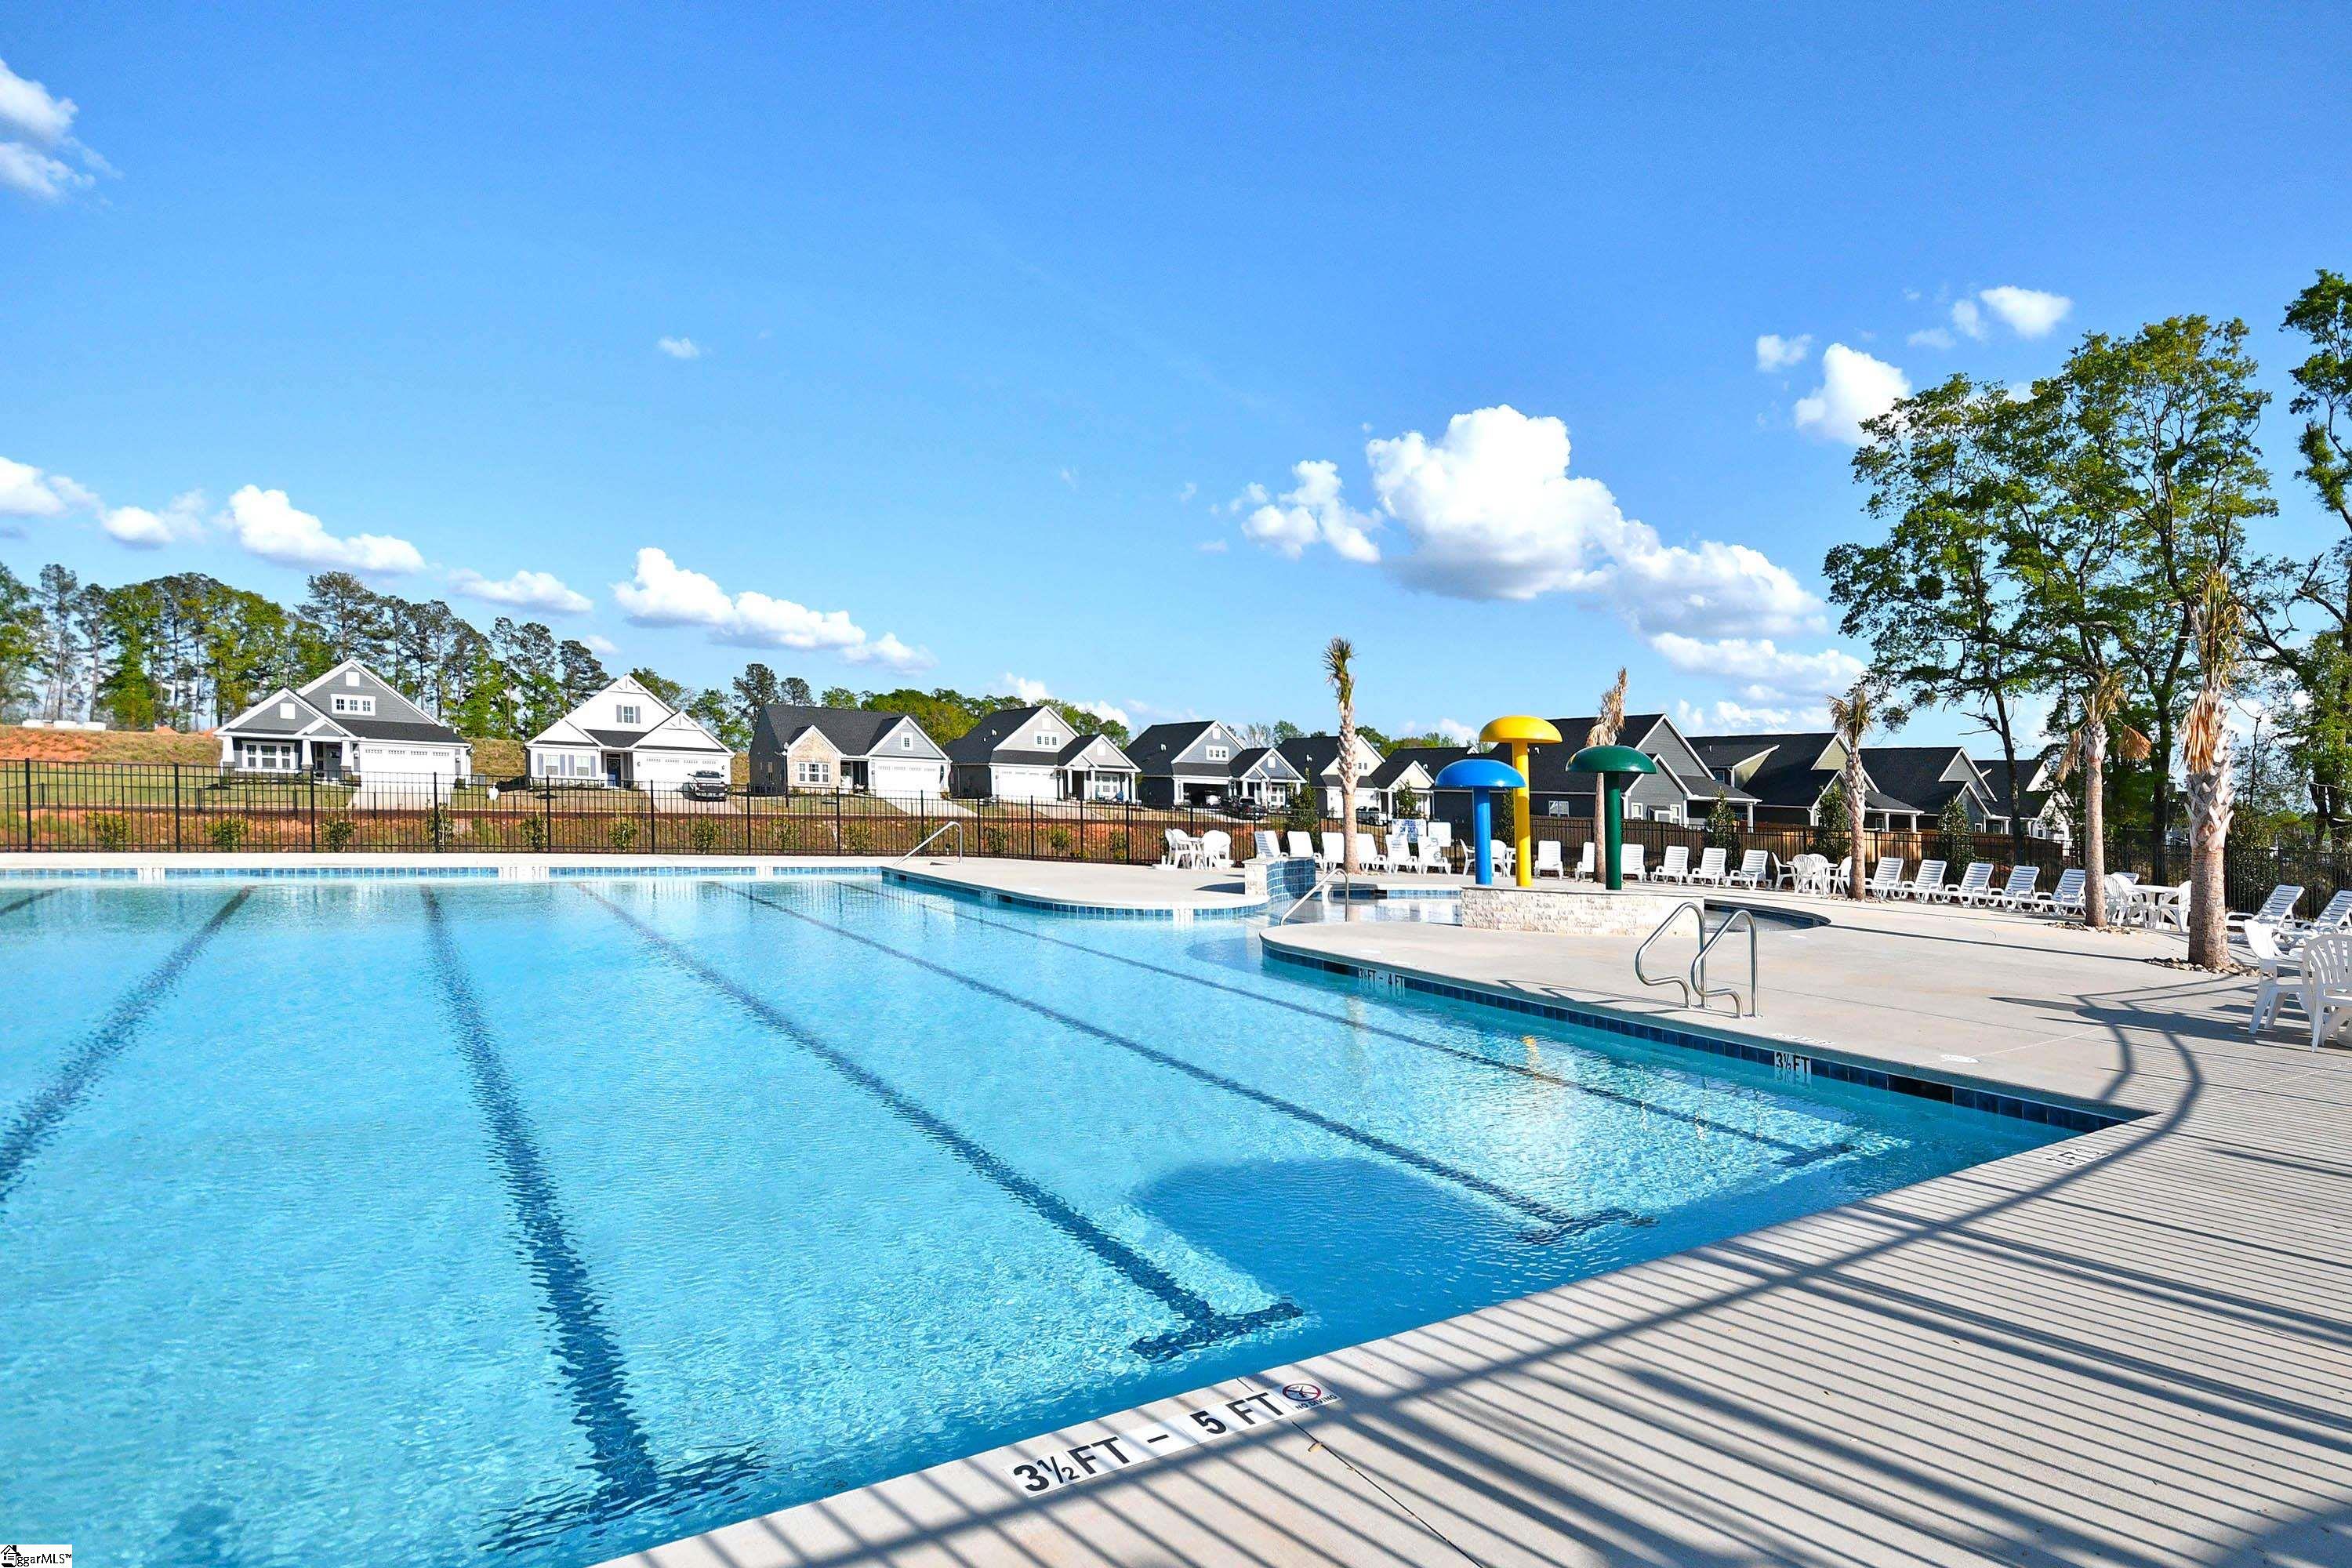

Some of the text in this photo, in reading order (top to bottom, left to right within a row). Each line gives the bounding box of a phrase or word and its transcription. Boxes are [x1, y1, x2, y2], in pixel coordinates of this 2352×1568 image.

[1189, 1410, 1227, 1436] 5
[1225, 1392, 1284, 1425] FT
[1308, 1394, 1338, 1406] DIVING
